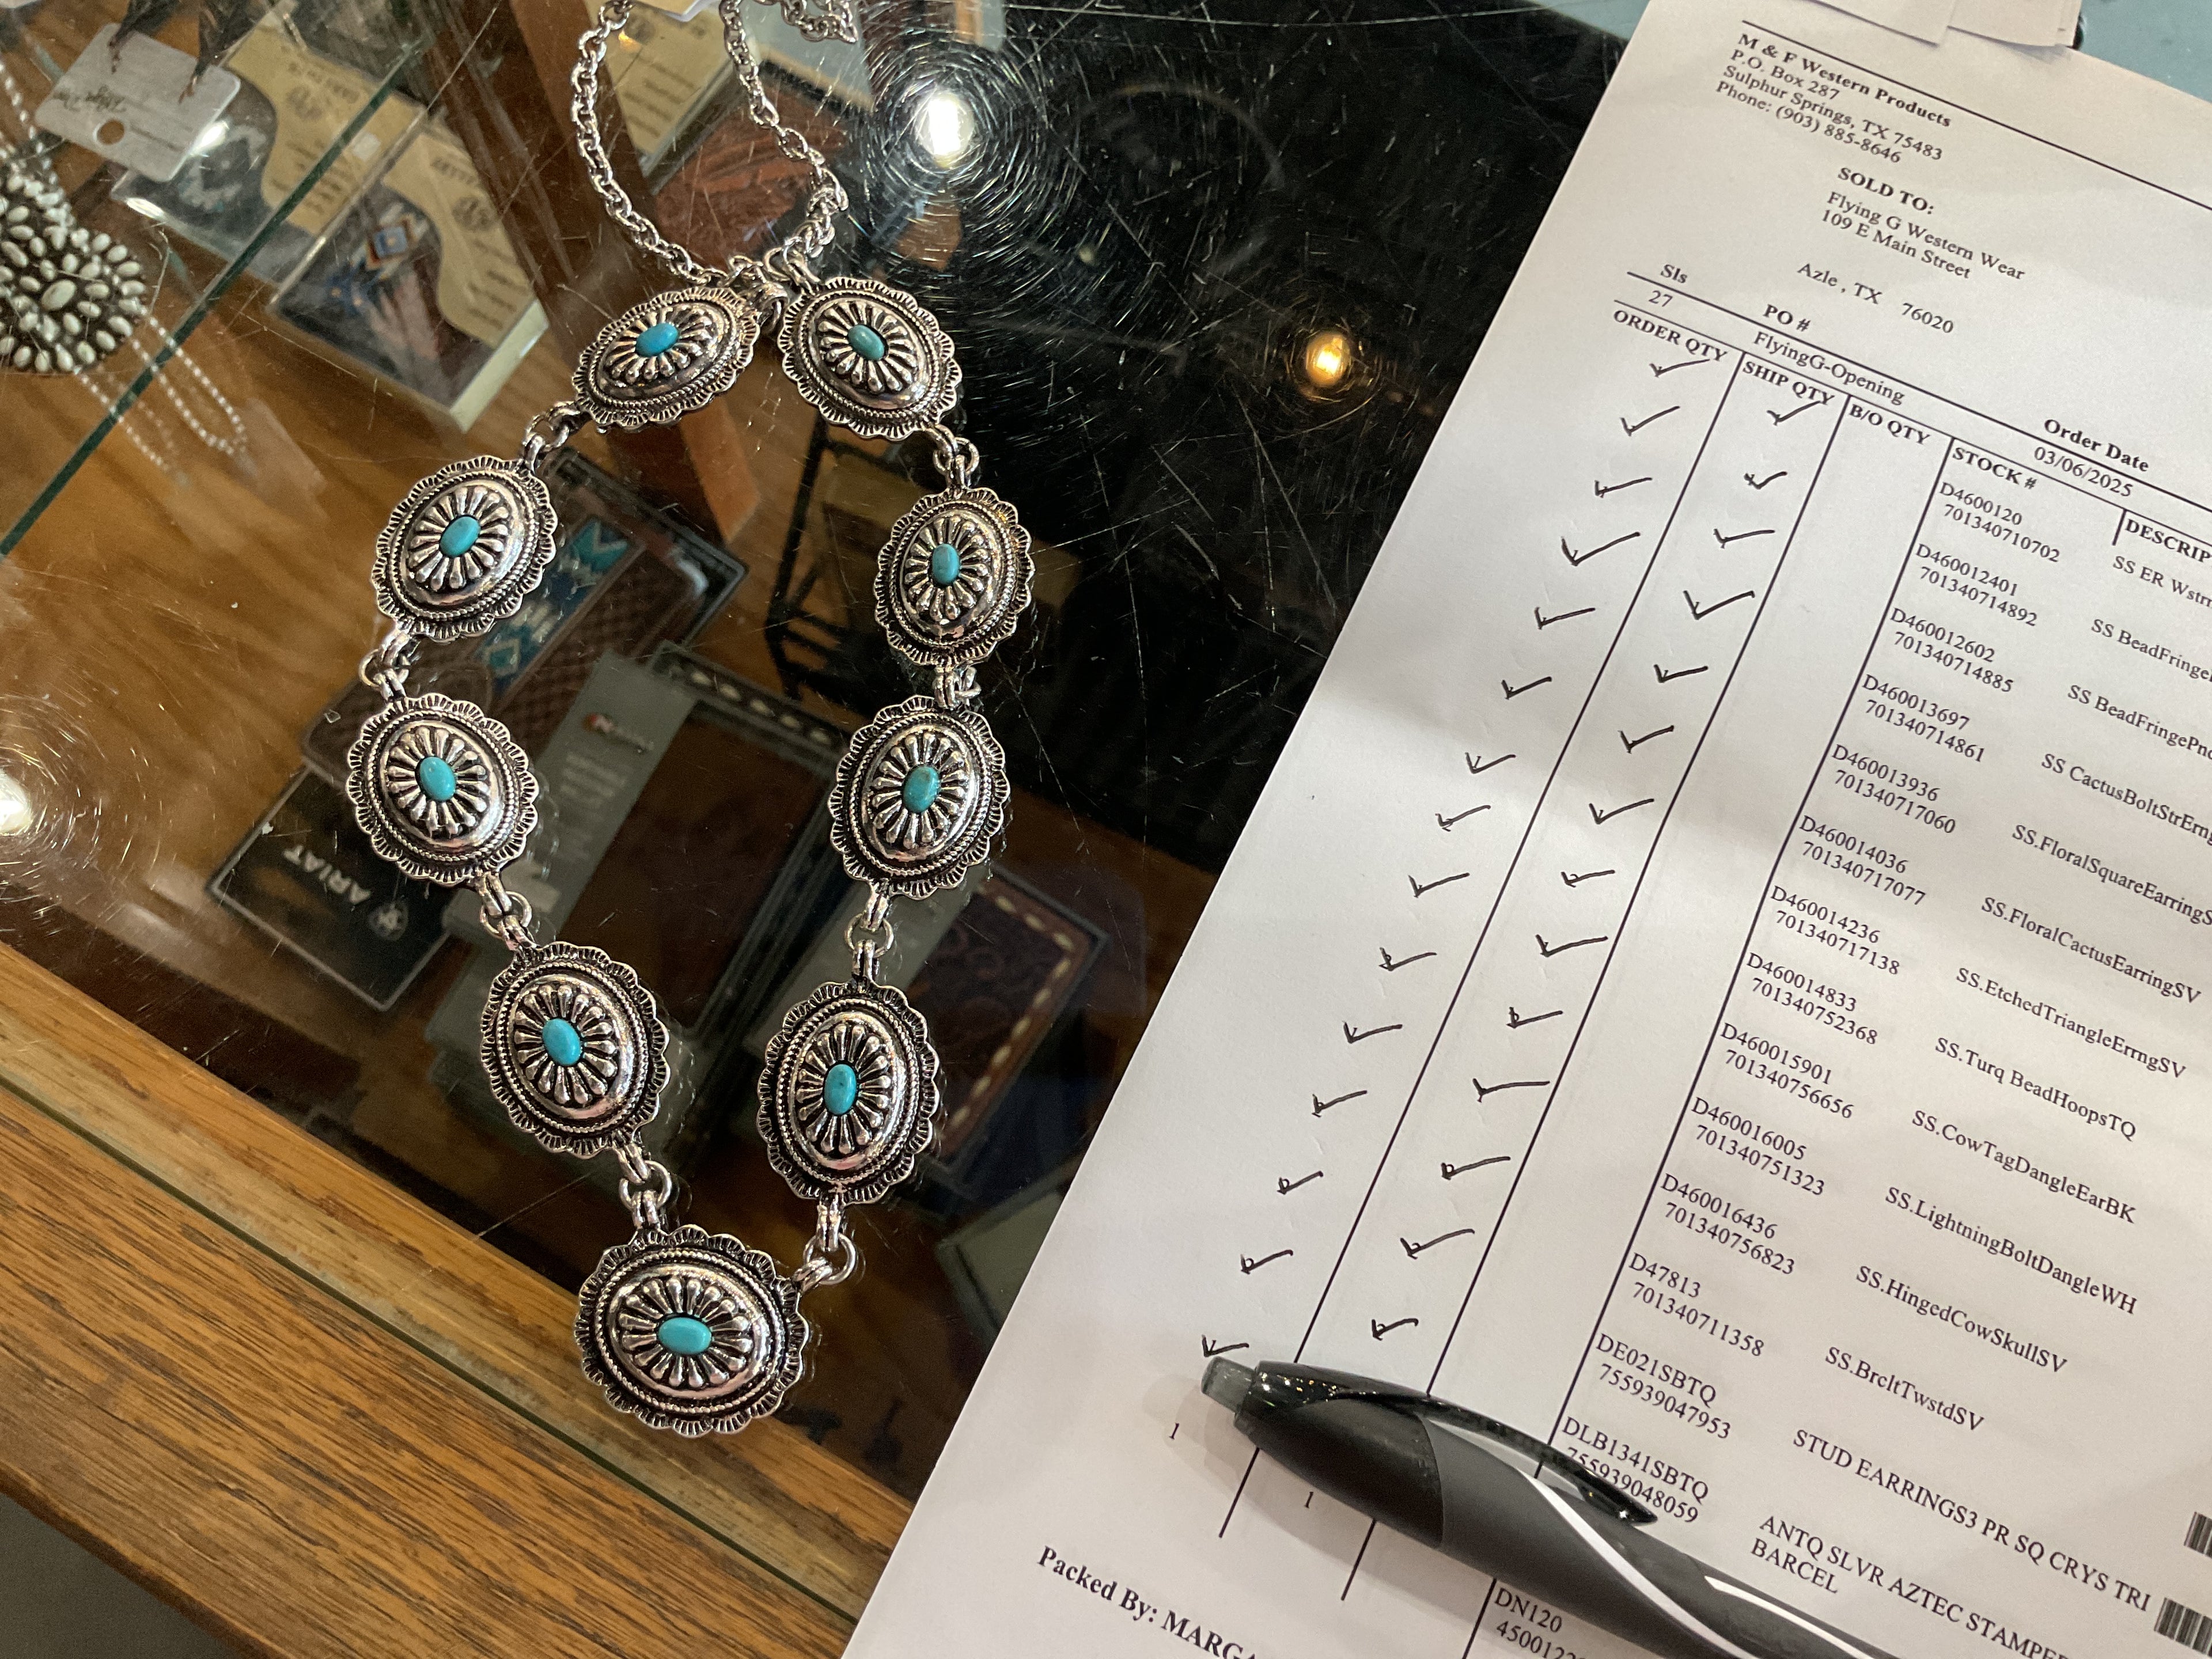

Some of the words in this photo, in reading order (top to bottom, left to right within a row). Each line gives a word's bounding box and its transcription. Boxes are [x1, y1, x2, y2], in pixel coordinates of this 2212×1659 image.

[1730, 48, 1765, 73] P.O.
[1770, 65, 1805, 88] Box
[1807, 80, 1840, 100] 287
[1738, 33, 1760, 50] M
[1761, 44, 1779, 58] &
[1783, 51, 1798, 65] F
[1801, 57, 1870, 95] Western
[1874, 88, 1951, 127] Products
[1715, 80, 1772, 112] Phone:
[1775, 105, 1820, 133] (903)
[1824, 124, 1902, 163] 885-8646
[1723, 65, 1788, 99] Sulphur
[1790, 92, 1855, 129] Springs,
[1862, 119, 1891, 140] TX
[1893, 132, 1942, 160] 75483
[1838, 167, 1894, 197] SOLD
[1900, 190, 1934, 215] TO:
[1822, 209, 1853, 230] 109
[1855, 222, 1870, 238] E
[1872, 229, 1917, 257] Main
[1921, 249, 1971, 279] Street
[1827, 191, 1882, 225] Flying
[1886, 215, 1902, 230] G
[1907, 222, 1974, 260] Western
[1981, 251, 2026, 280] Wear
[1648, 290, 1673, 308] 27
[1660, 264, 1688, 284] Sls
[1797, 263, 1838, 287] Azle
[1854, 282, 1883, 305] TX
[1902, 302, 1954, 334] 76020
[1613, 310, 1681, 346] ORDER
[1685, 338, 1728, 362] QTY
[1762, 304, 1794, 325] PO
[1796, 318, 1811, 332] #
[1742, 361, 1789, 387] SHIP
[1791, 381, 1835, 406] QTY
[1752, 331, 1906, 406] FlyingG-Opening
[1848, 403, 1884, 426] B/O
[1887, 420, 1931, 445] QTY
[2044, 419, 2103, 452] Order
[2104, 442, 2149, 472] Date
[1952, 447, 2021, 485] STOCK
[2024, 476, 2038, 490] #
[2033, 446, 2134, 497] 03/06/2025
[1938, 481, 2022, 525] D4600120
[1944, 503, 2060, 563] 701340710702
[1915, 543, 2018, 597] D460012401
[2112, 555, 2136, 574] SS
[2139, 566, 2164, 588] ER
[2124, 518, 2212, 563] DESCRIP
[1920, 566, 2037, 627] 701340714892
[1889, 607, 1995, 663] D460012602
[1894, 631, 2014, 692] 701340714885
[2090, 619, 2115, 638] SS
[2116, 629, 2212, 683] BeadFringe
[1861, 673, 1971, 730] D460013697
[2067, 684, 2092, 704] SS
[1865, 699, 1985, 763] 701340714861
[1831, 744, 1941, 801] D460013936
[2041, 753, 2067, 774] SS
[1835, 769, 1956, 834] 701340717060
[1798, 815, 1909, 873] D460014036
[1802, 840, 1927, 906] 701340717077
[1770, 885, 1881, 944] D460014236
[1776, 910, 1900, 975] 701340717138
[1981, 897, 2202, 1003] SS.FloralCactusEarringSV
[1746, 952, 1857, 1012] D460014833
[1752, 977, 1878, 1045] 701340752368
[1719, 1022, 1832, 1085] D460015901
[1725, 1049, 1855, 1119] 701340756656
[1935, 1037, 2005, 1085] SS.Turq
[2009, 1069, 2136, 1142] BeadHoopsTQ
[1691, 1096, 1807, 1161] D460016005
[1696, 1124, 1825, 1196] 701340751323
[1912, 1110, 2137, 1224] SS.CowTagDangleEarBK
[1660, 1173, 1778, 1239] D460016436
[1665, 1202, 1795, 1275] 701340756823
[1885, 1187, 2138, 1315] SS.LightningBoltDangleWH
[1628, 1252, 1701, 1298] D47813
[1633, 1281, 1764, 1357] 701340711358
[1856, 1266, 2068, 1373] SS.HingedCowSkullSV
[1596, 1332, 1717, 1409] DE021SBTQ
[1599, 1363, 1731, 1439] 755939047953
[1825, 1346, 1985, 1431] SS.BrcltTwstdSV
[1562, 1416, 1709, 1505] DLB1341SBTQ
[1793, 1429, 1853, 1468] STUD
[1854, 1458, 1978, 1529] EARRINGS3
[1981, 1517, 2010, 1546] PR
[2014, 1535, 2045, 1566] SQ
[2049, 1551, 2109, 1592] CRYS
[2114, 1580, 2152, 1612] TRI
[1750, 1537, 1838, 1594] BARCEL
[1759, 1516, 1824, 1562] ANTQ
[1827, 1546, 1885, 1588] SLVR
[1888, 1577, 1964, 1623] AZTEC
[1965, 1612, 2070, 1659] STAMPE
[1036, 1545, 1118, 1601] Packed
[1118, 1587, 1157, 1622] By:
[1160, 1609, 1256, 1659] MARG
[1494, 1588, 1562, 1633] DN120
[1496, 1620, 1586, 1659] 450012
